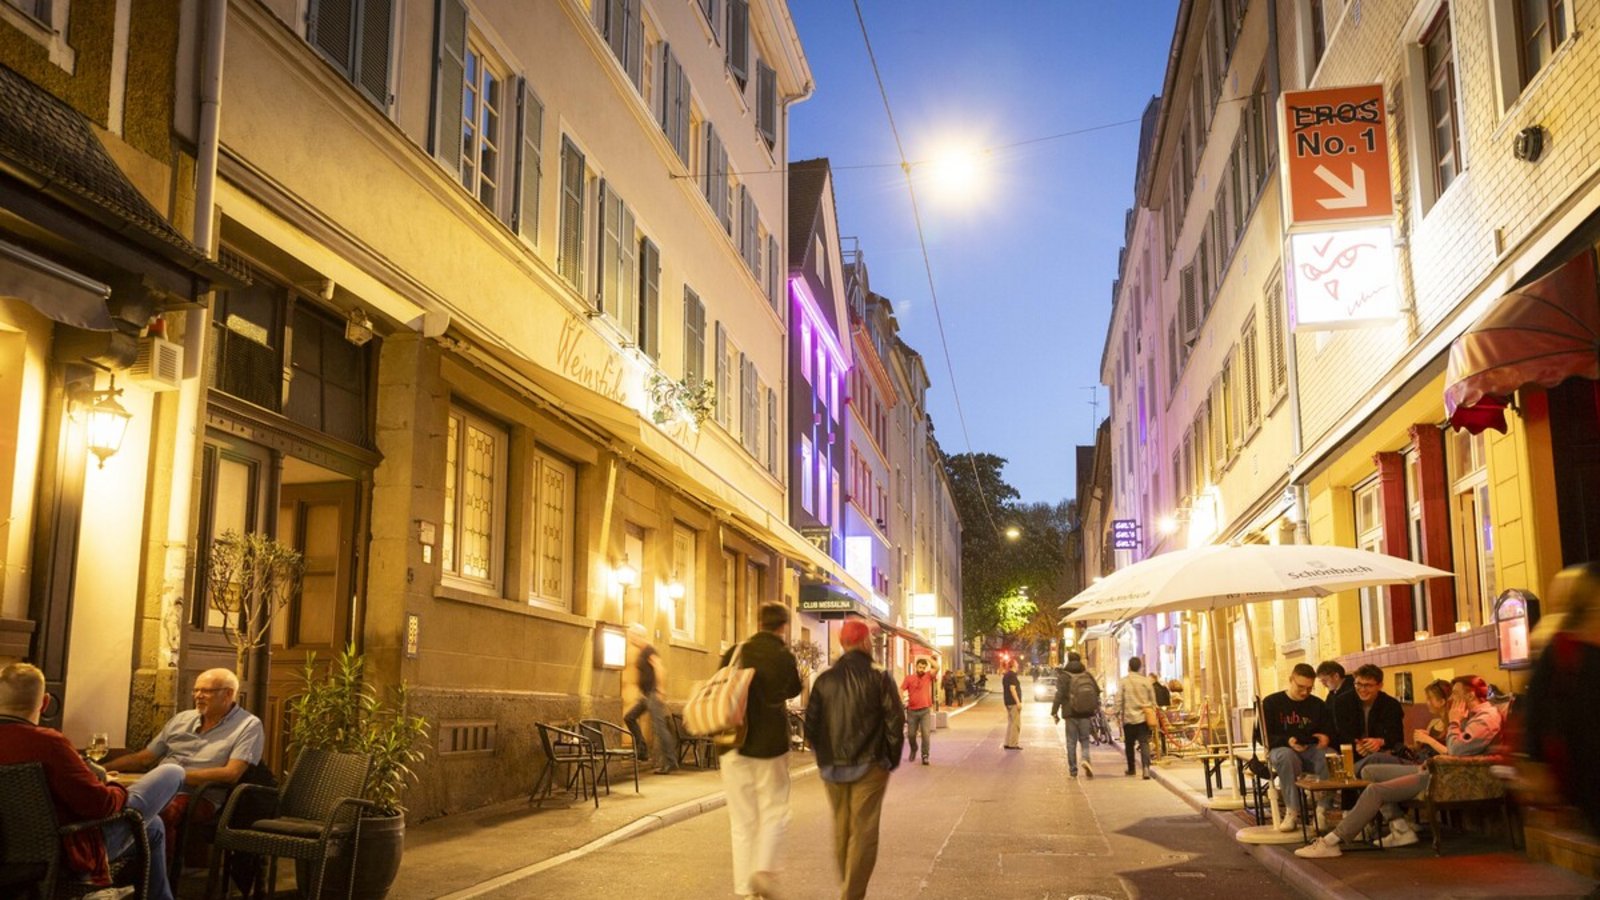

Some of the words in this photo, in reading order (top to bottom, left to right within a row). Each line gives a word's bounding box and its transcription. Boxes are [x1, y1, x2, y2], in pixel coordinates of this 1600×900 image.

[1294, 100, 1379, 127] EROS
[1296, 127, 1376, 157] No.1
[1288, 564, 1374, 580] Schönbuch
[803, 601, 818, 609] CLUB
[819, 600, 850, 609] MESSALINA
